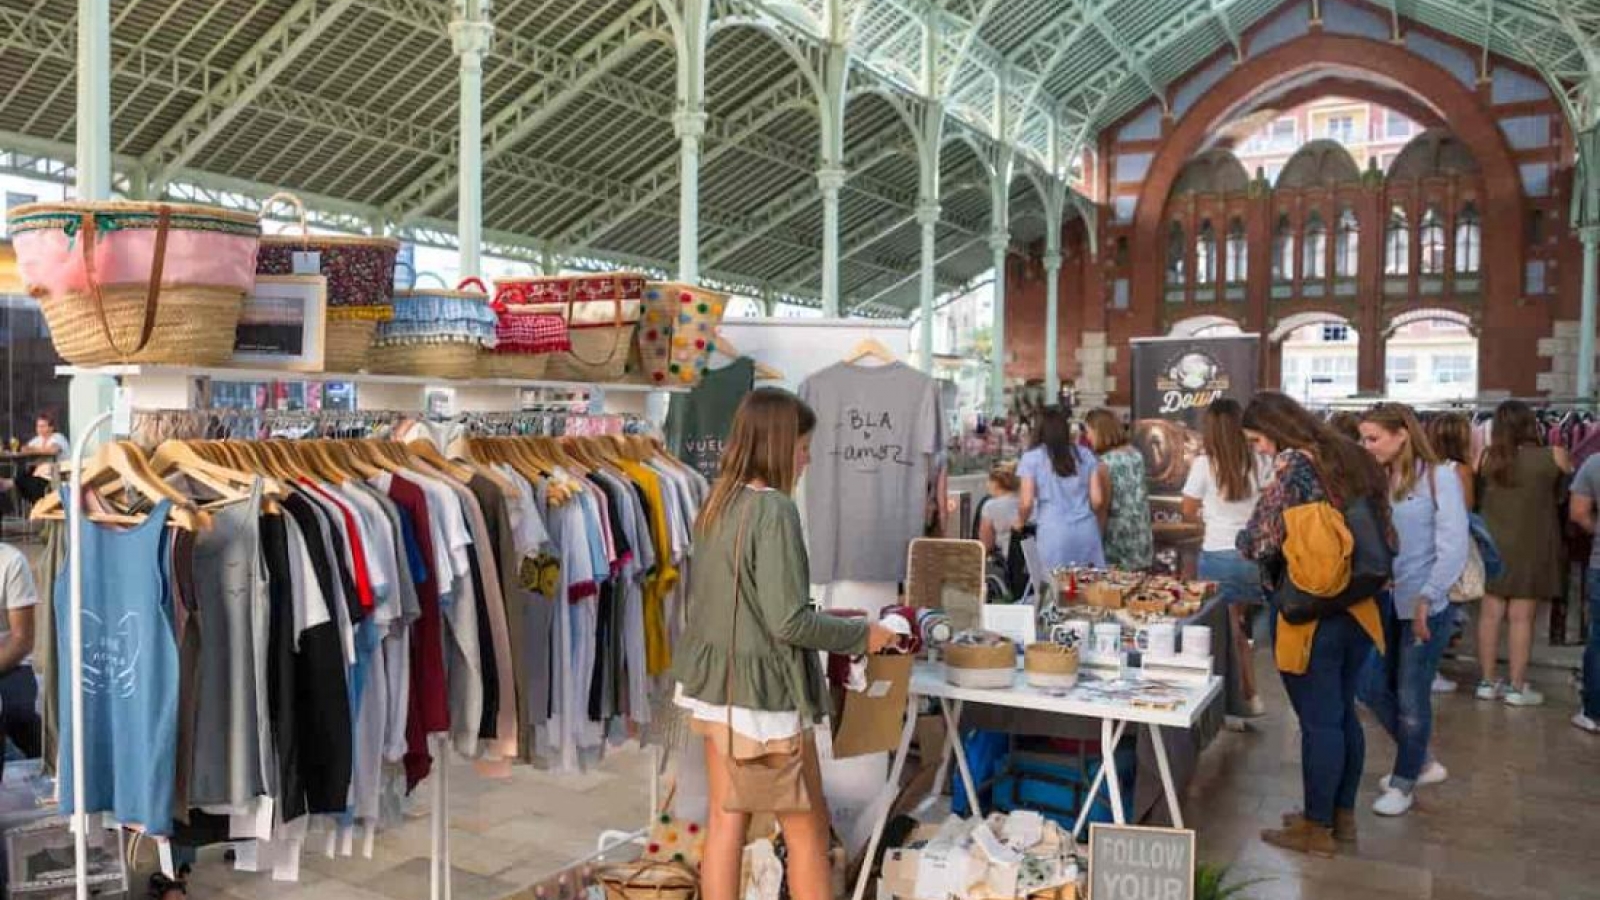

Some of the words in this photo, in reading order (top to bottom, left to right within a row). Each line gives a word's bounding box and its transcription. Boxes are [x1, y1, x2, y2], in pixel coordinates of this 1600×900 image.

[686, 439, 724, 452] VUEL
[1103, 838, 1185, 872] FOLLOW
[1103, 872, 1182, 900] YOUR
